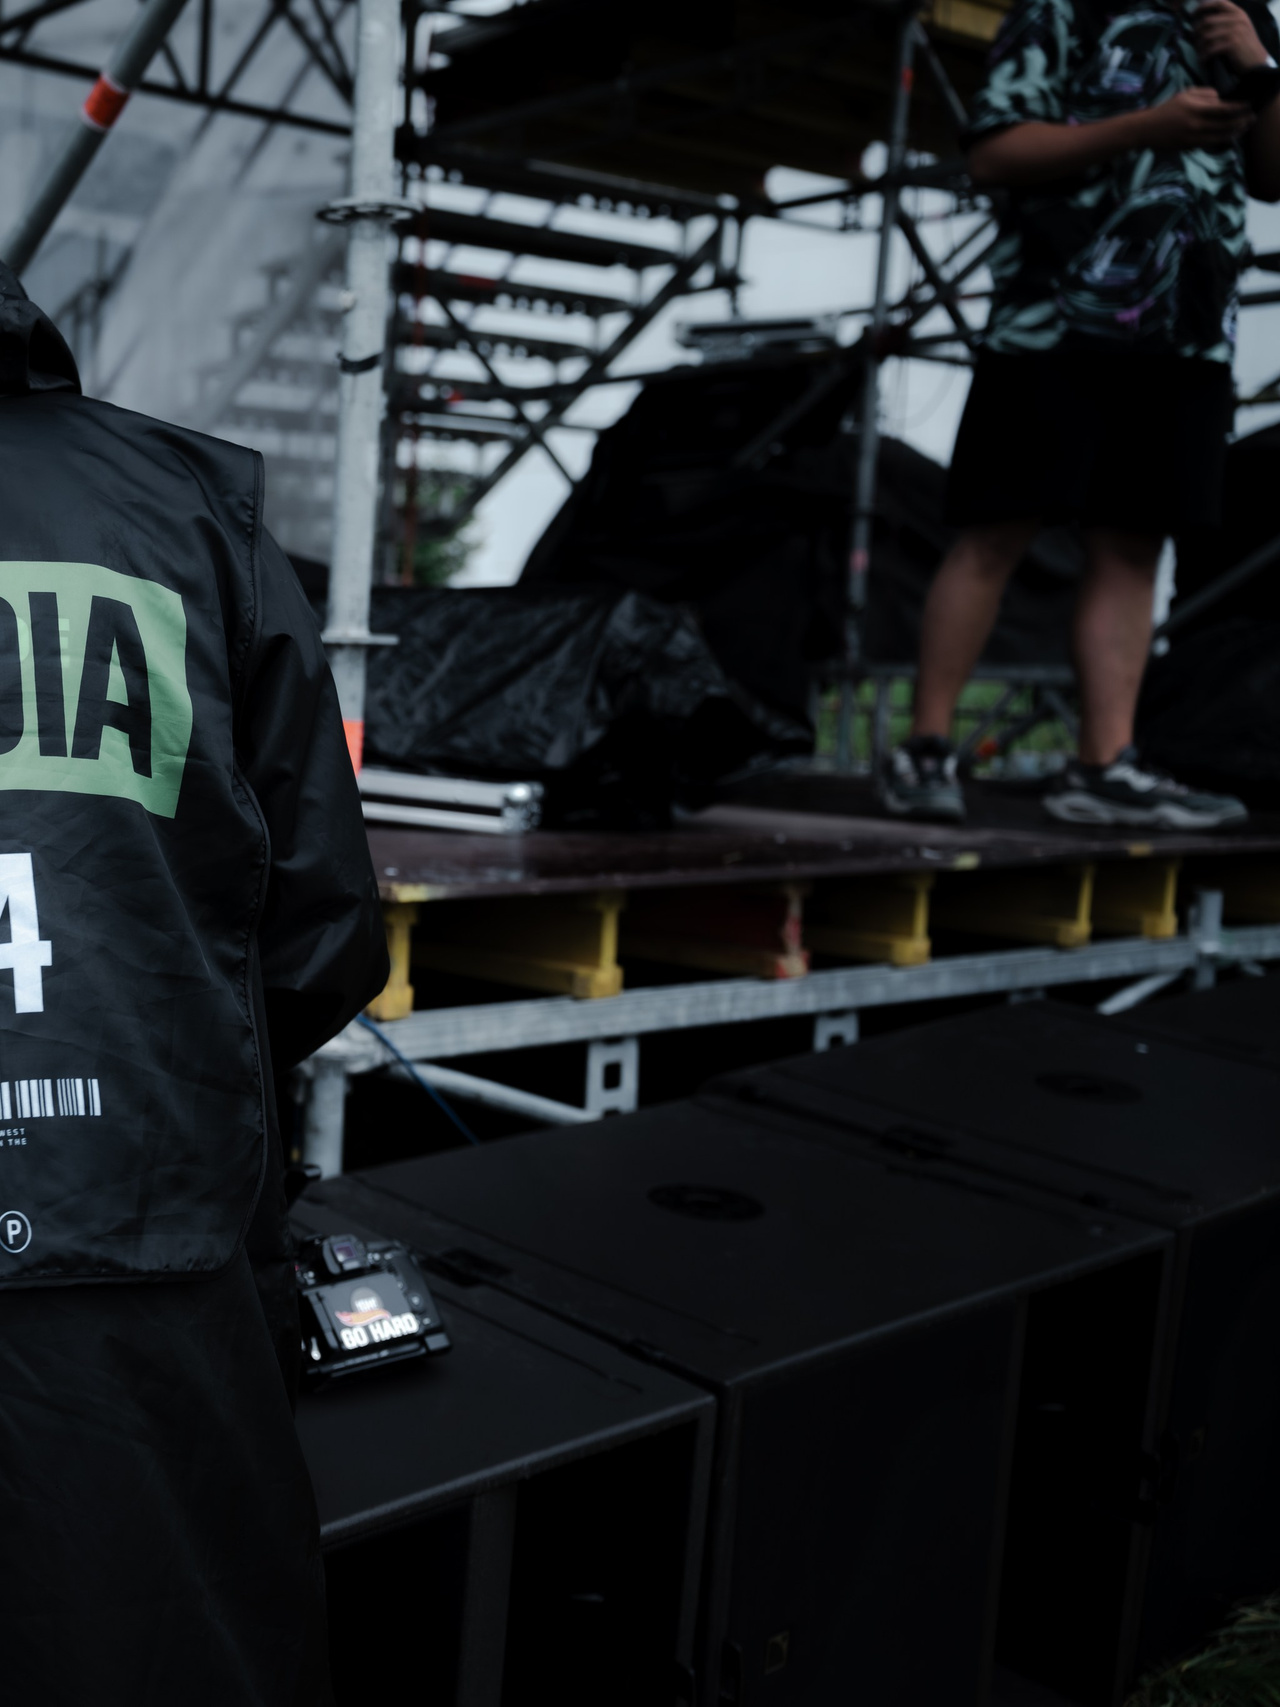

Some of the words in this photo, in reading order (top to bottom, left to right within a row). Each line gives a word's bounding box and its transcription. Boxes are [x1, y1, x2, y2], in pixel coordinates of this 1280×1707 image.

[7, 1137, 27, 1146] THE
[6, 1219, 22, 1245] P
[340, 1326, 370, 1350] GO
[368, 1311, 420, 1343] HARD
